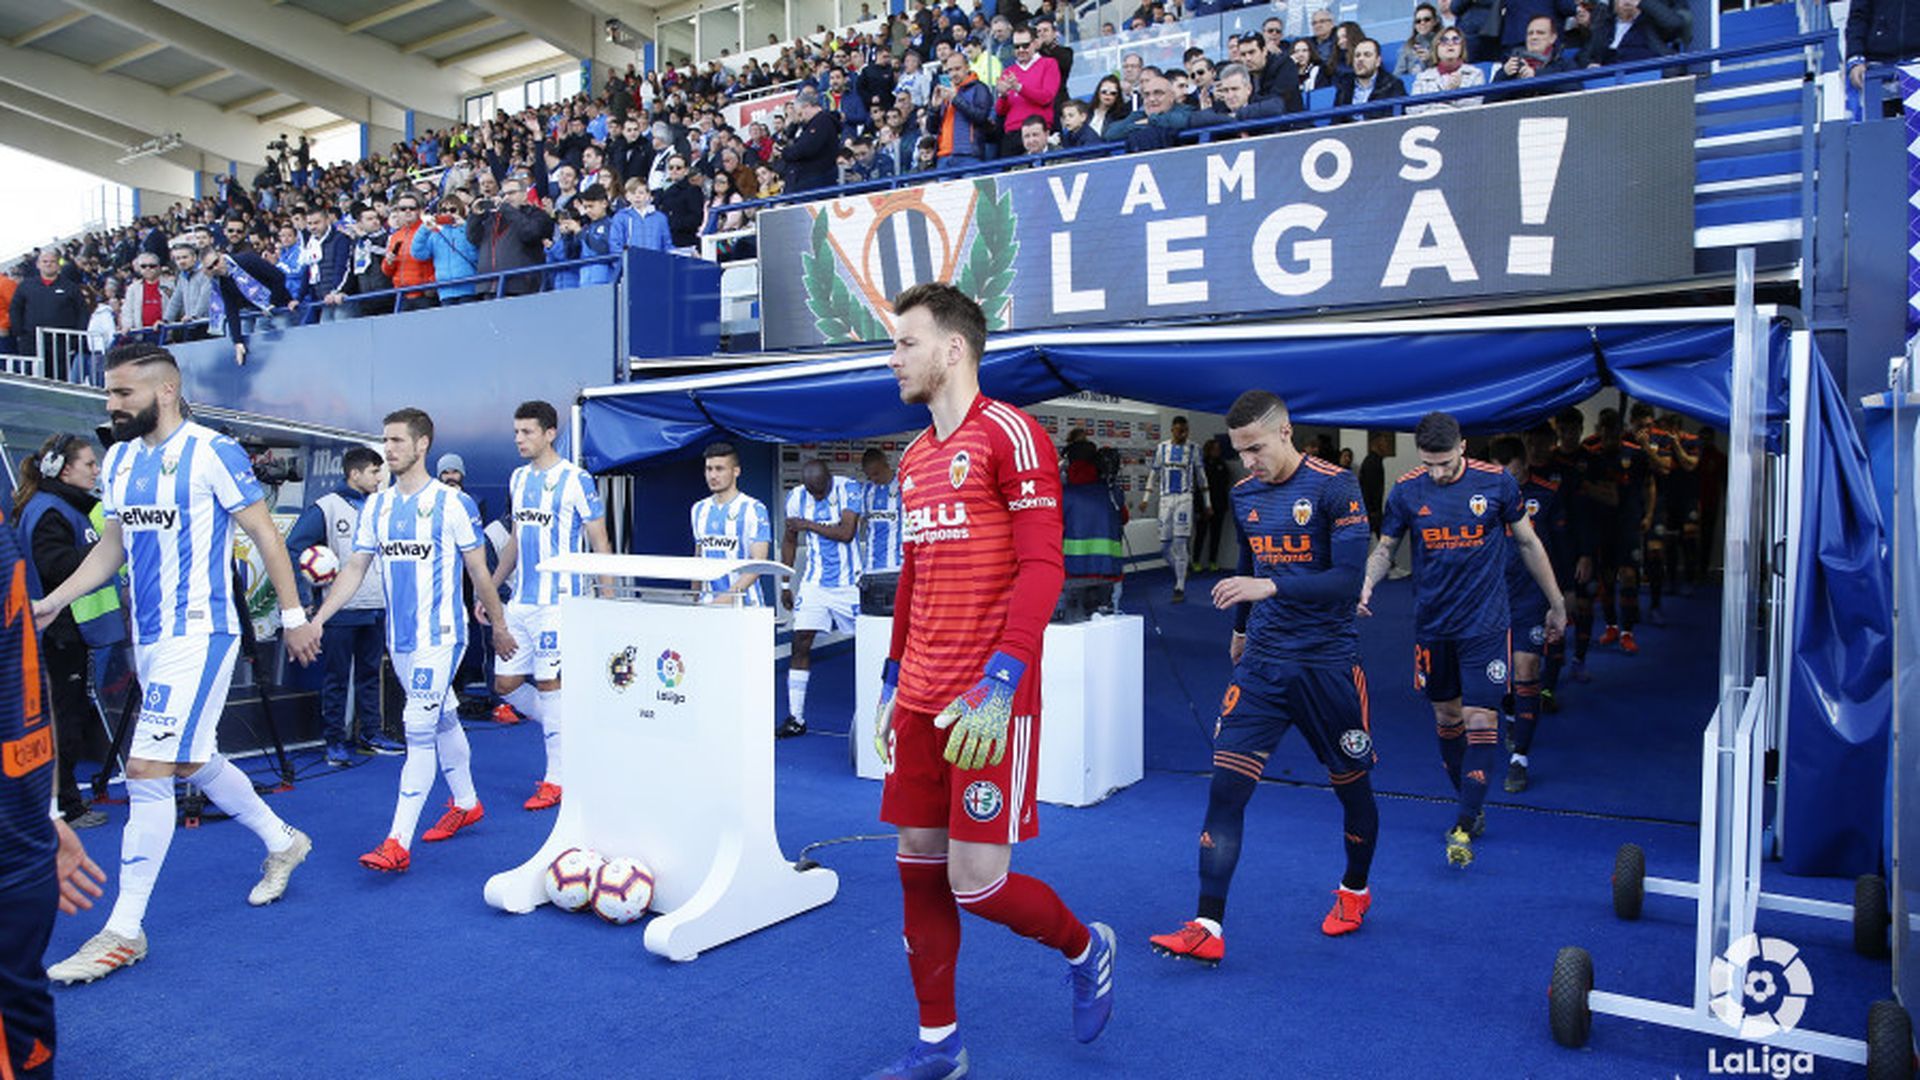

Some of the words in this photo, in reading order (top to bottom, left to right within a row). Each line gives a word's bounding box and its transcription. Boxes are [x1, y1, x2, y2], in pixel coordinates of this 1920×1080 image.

[1047, 125, 1444, 223] VAMOS
[117, 507, 177, 529] etway
[1422, 524, 1484, 542] BLU
[1248, 534, 1311, 555] BLU
[656, 690, 686, 705] LaLiga
[1222, 684, 1241, 717] 9
